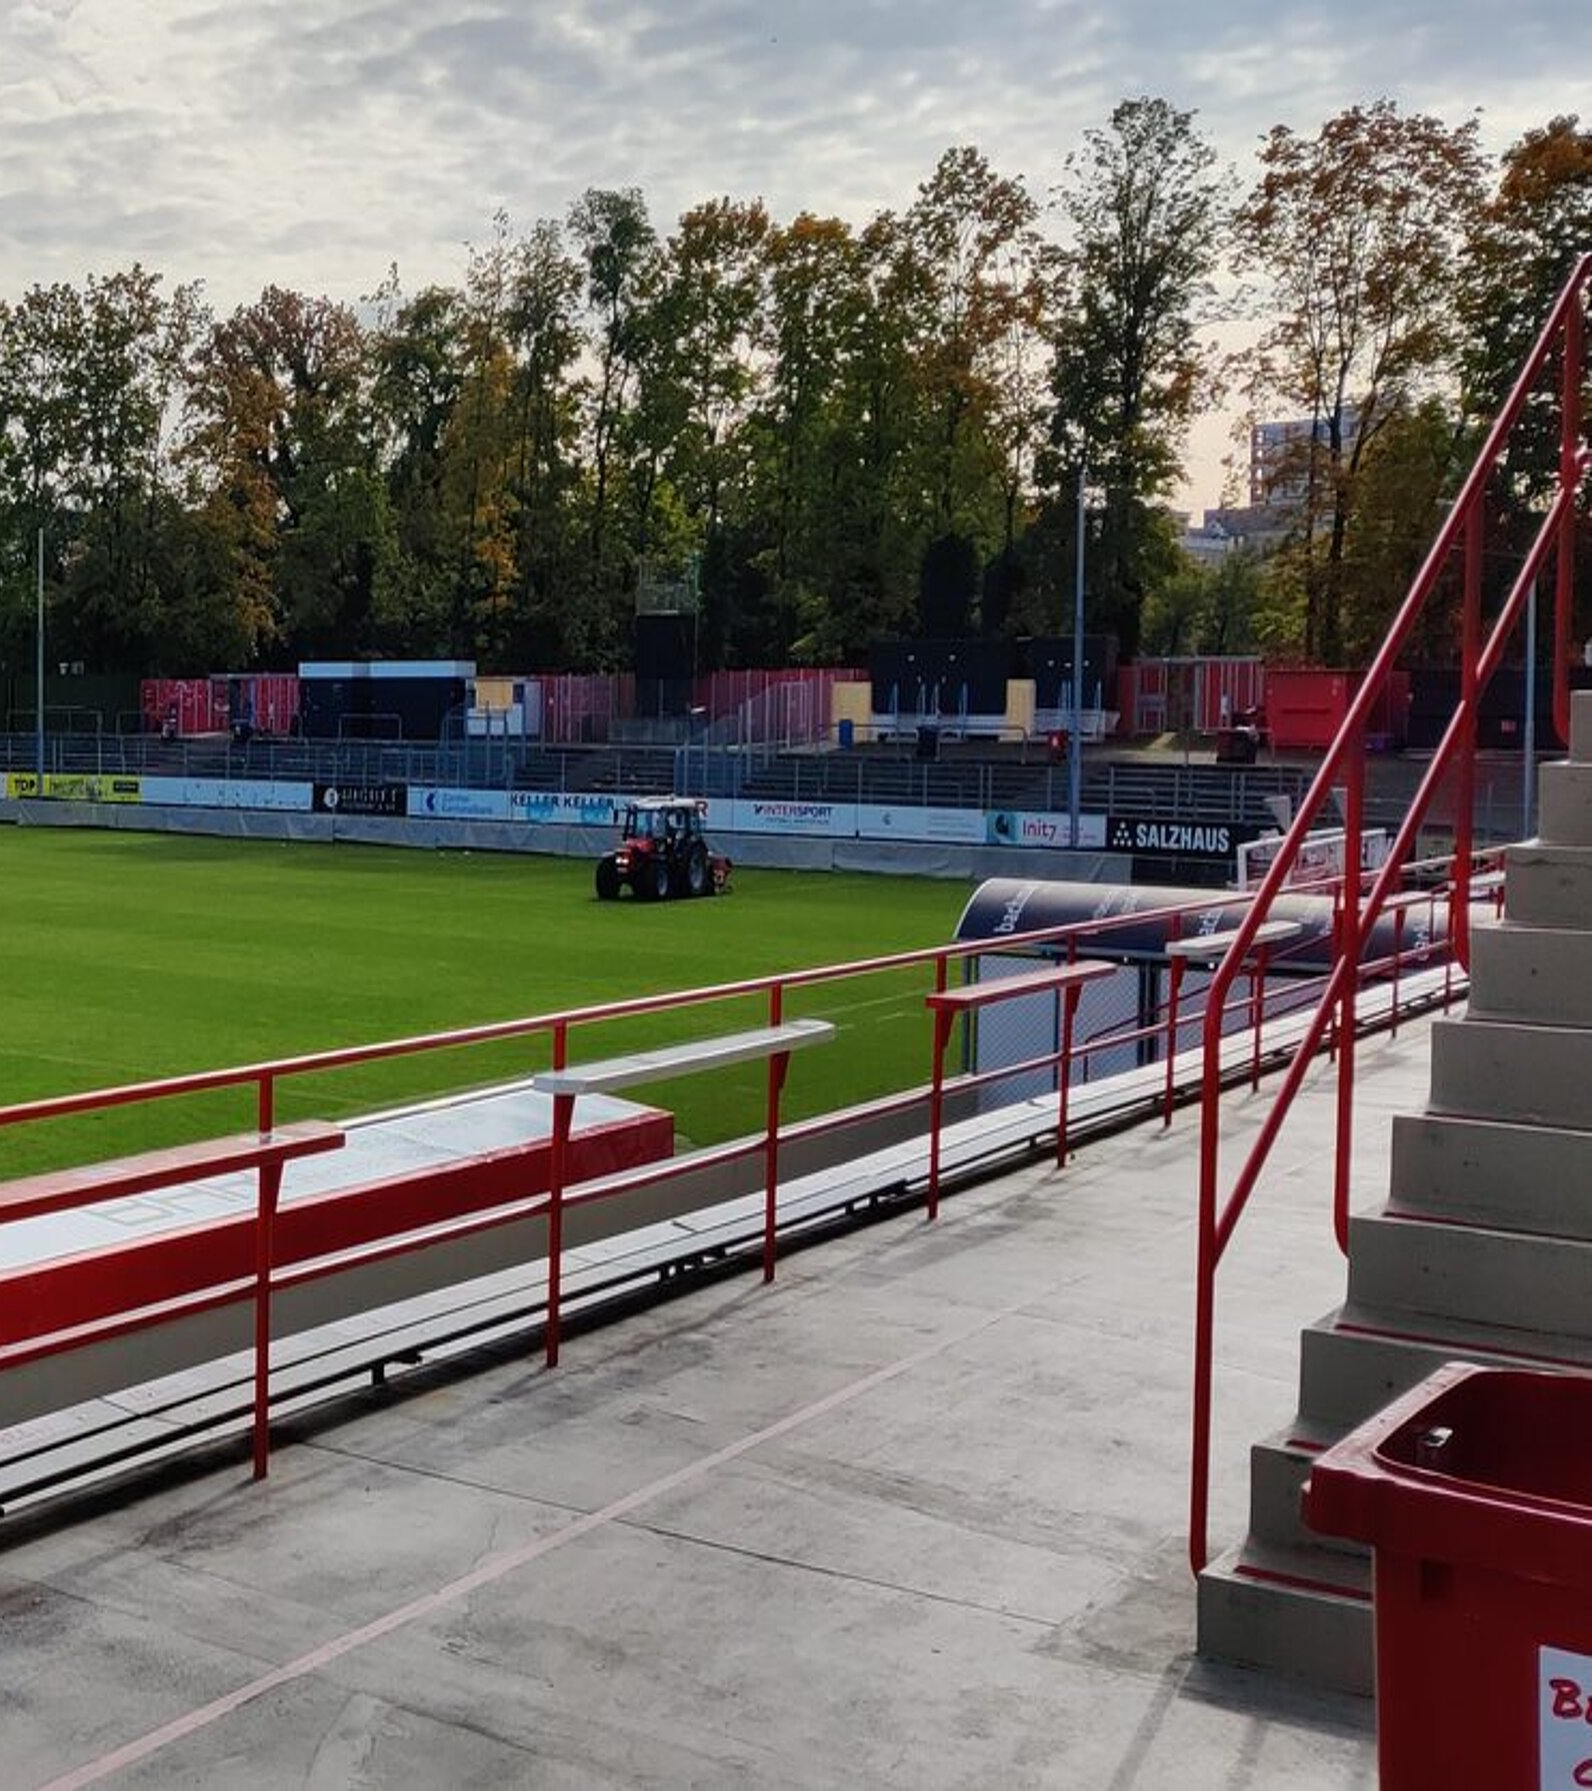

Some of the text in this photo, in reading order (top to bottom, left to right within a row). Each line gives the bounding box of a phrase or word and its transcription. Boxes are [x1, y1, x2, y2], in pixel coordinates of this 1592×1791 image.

[511, 793, 559, 807] KELLER
[763, 803, 833, 817] INTERSPORT
[1022, 818, 1057, 841] Init7
[1135, 823, 1230, 852] SALZHAUS
